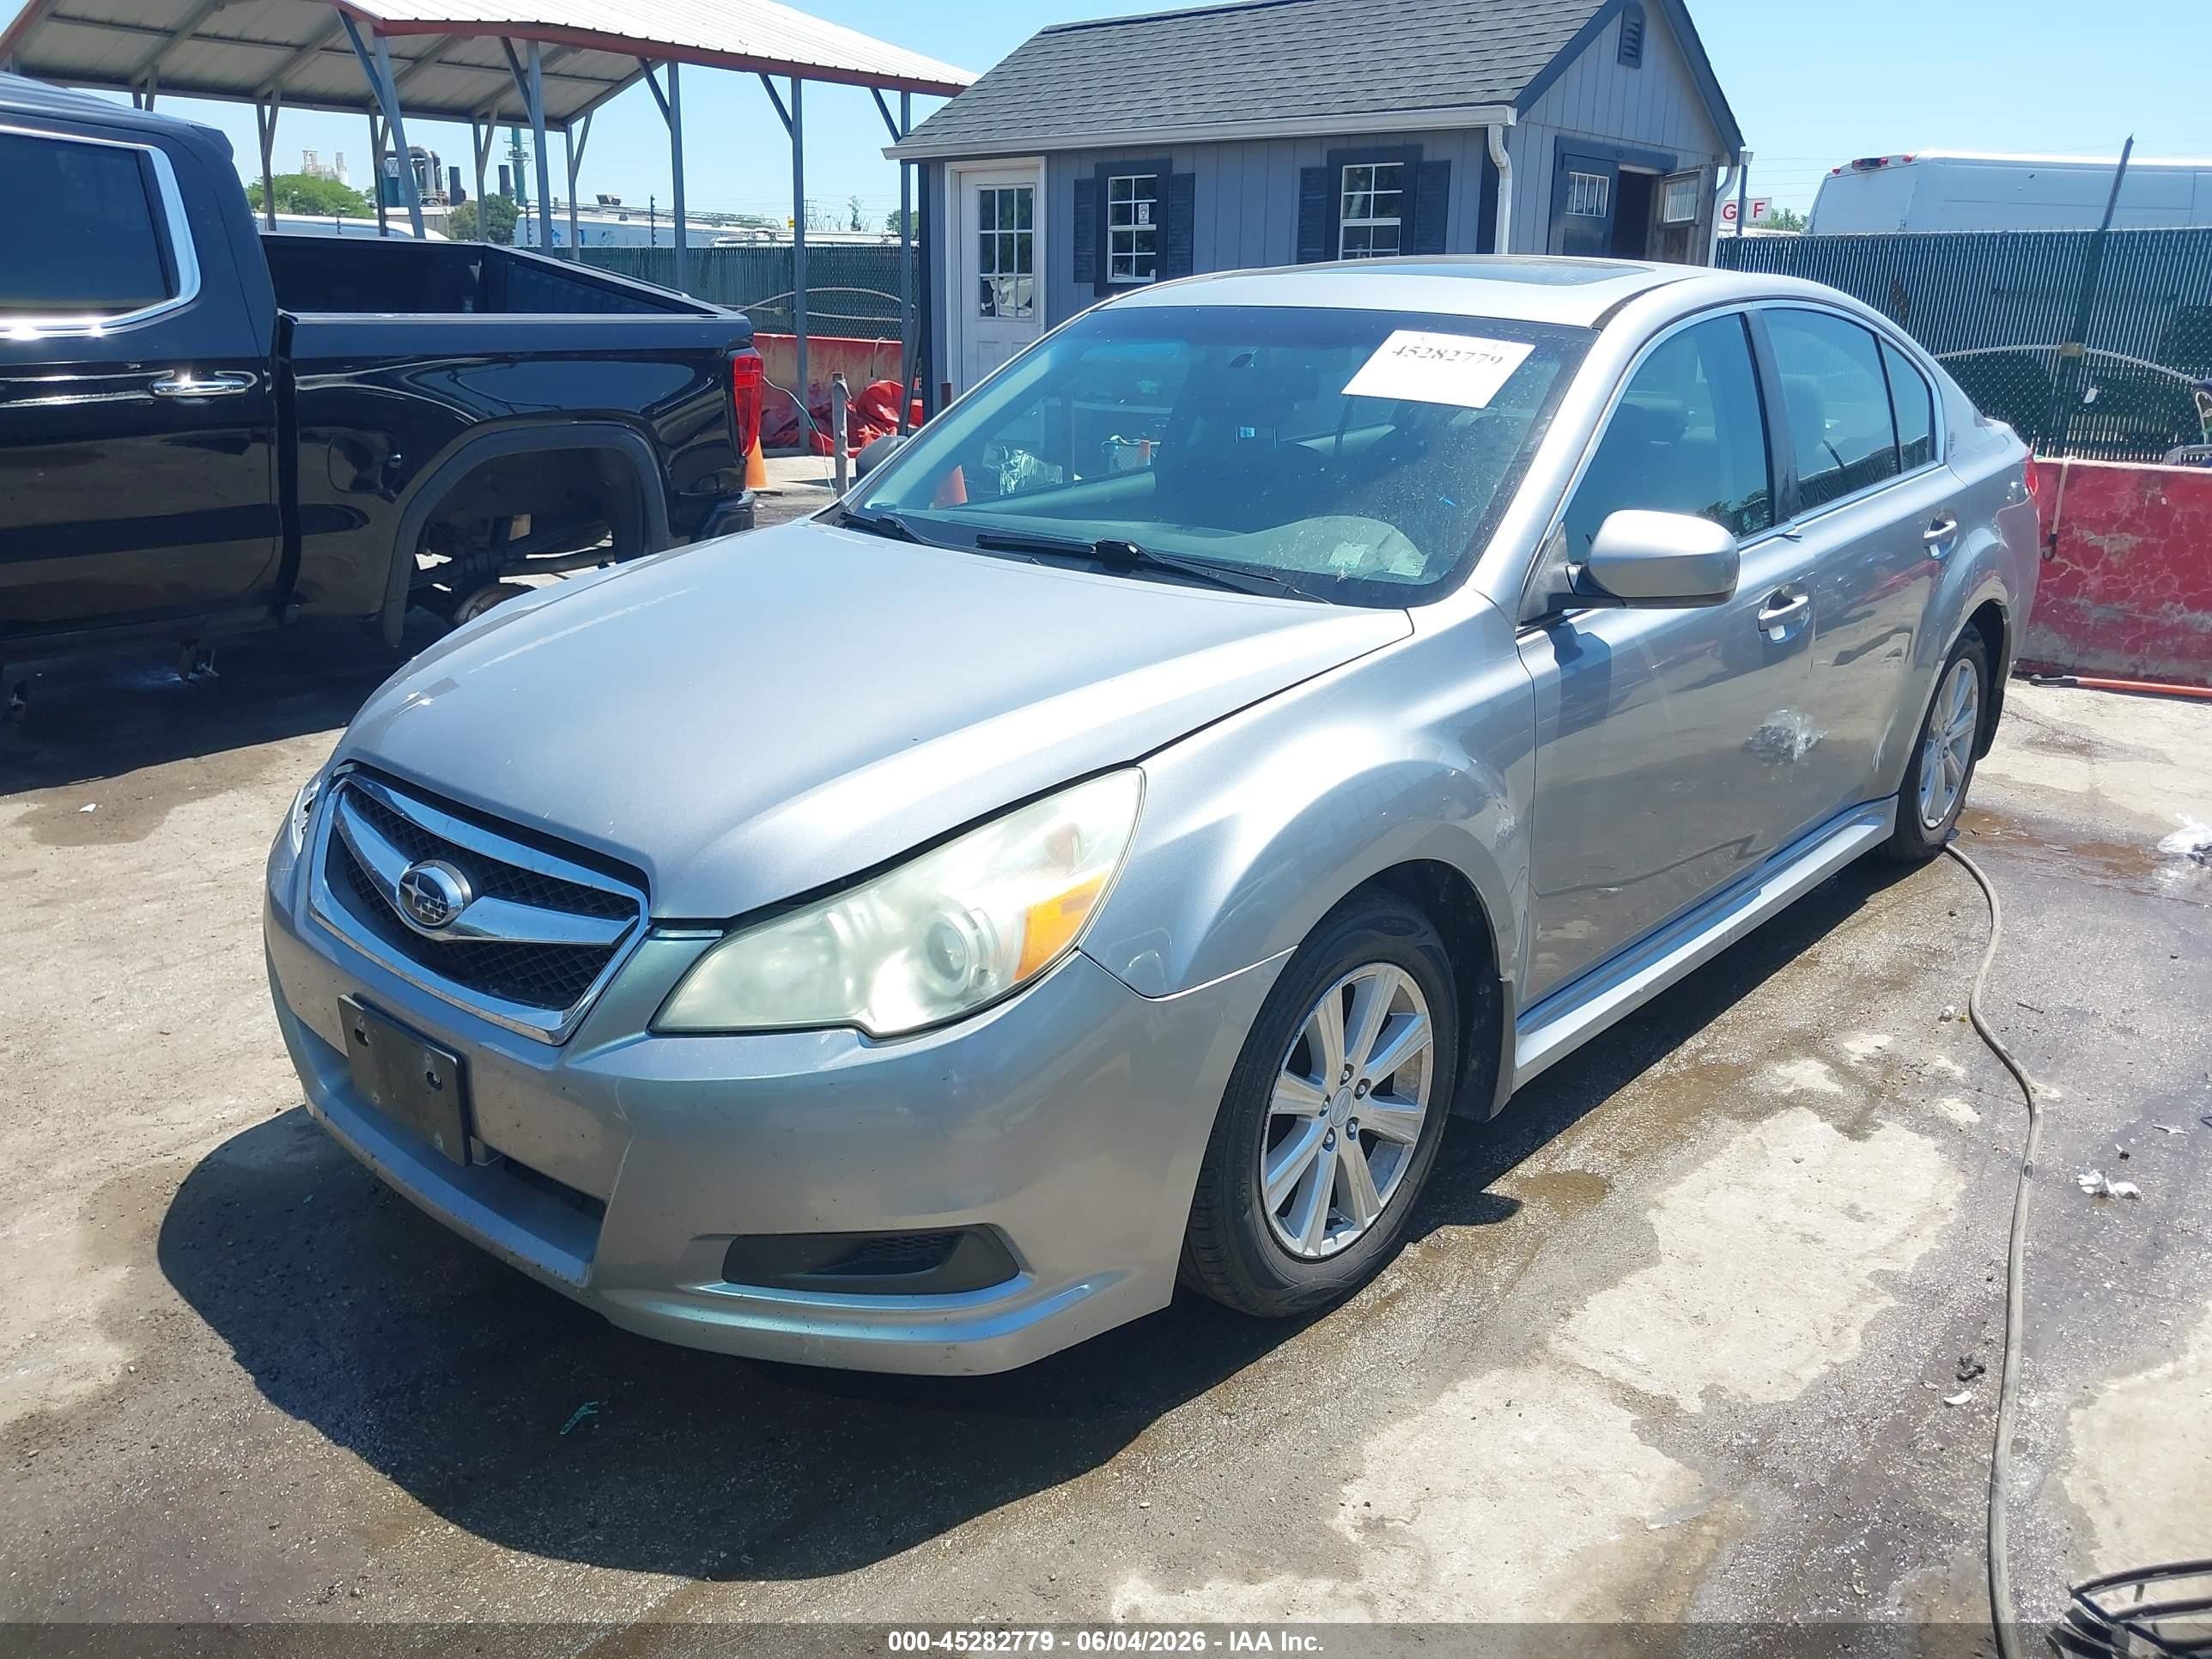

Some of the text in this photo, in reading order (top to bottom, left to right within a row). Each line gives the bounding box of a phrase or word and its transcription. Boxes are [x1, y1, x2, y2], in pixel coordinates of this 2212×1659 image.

[1723, 202, 1765, 220] G F
[1392, 344, 1504, 366] 45282779
